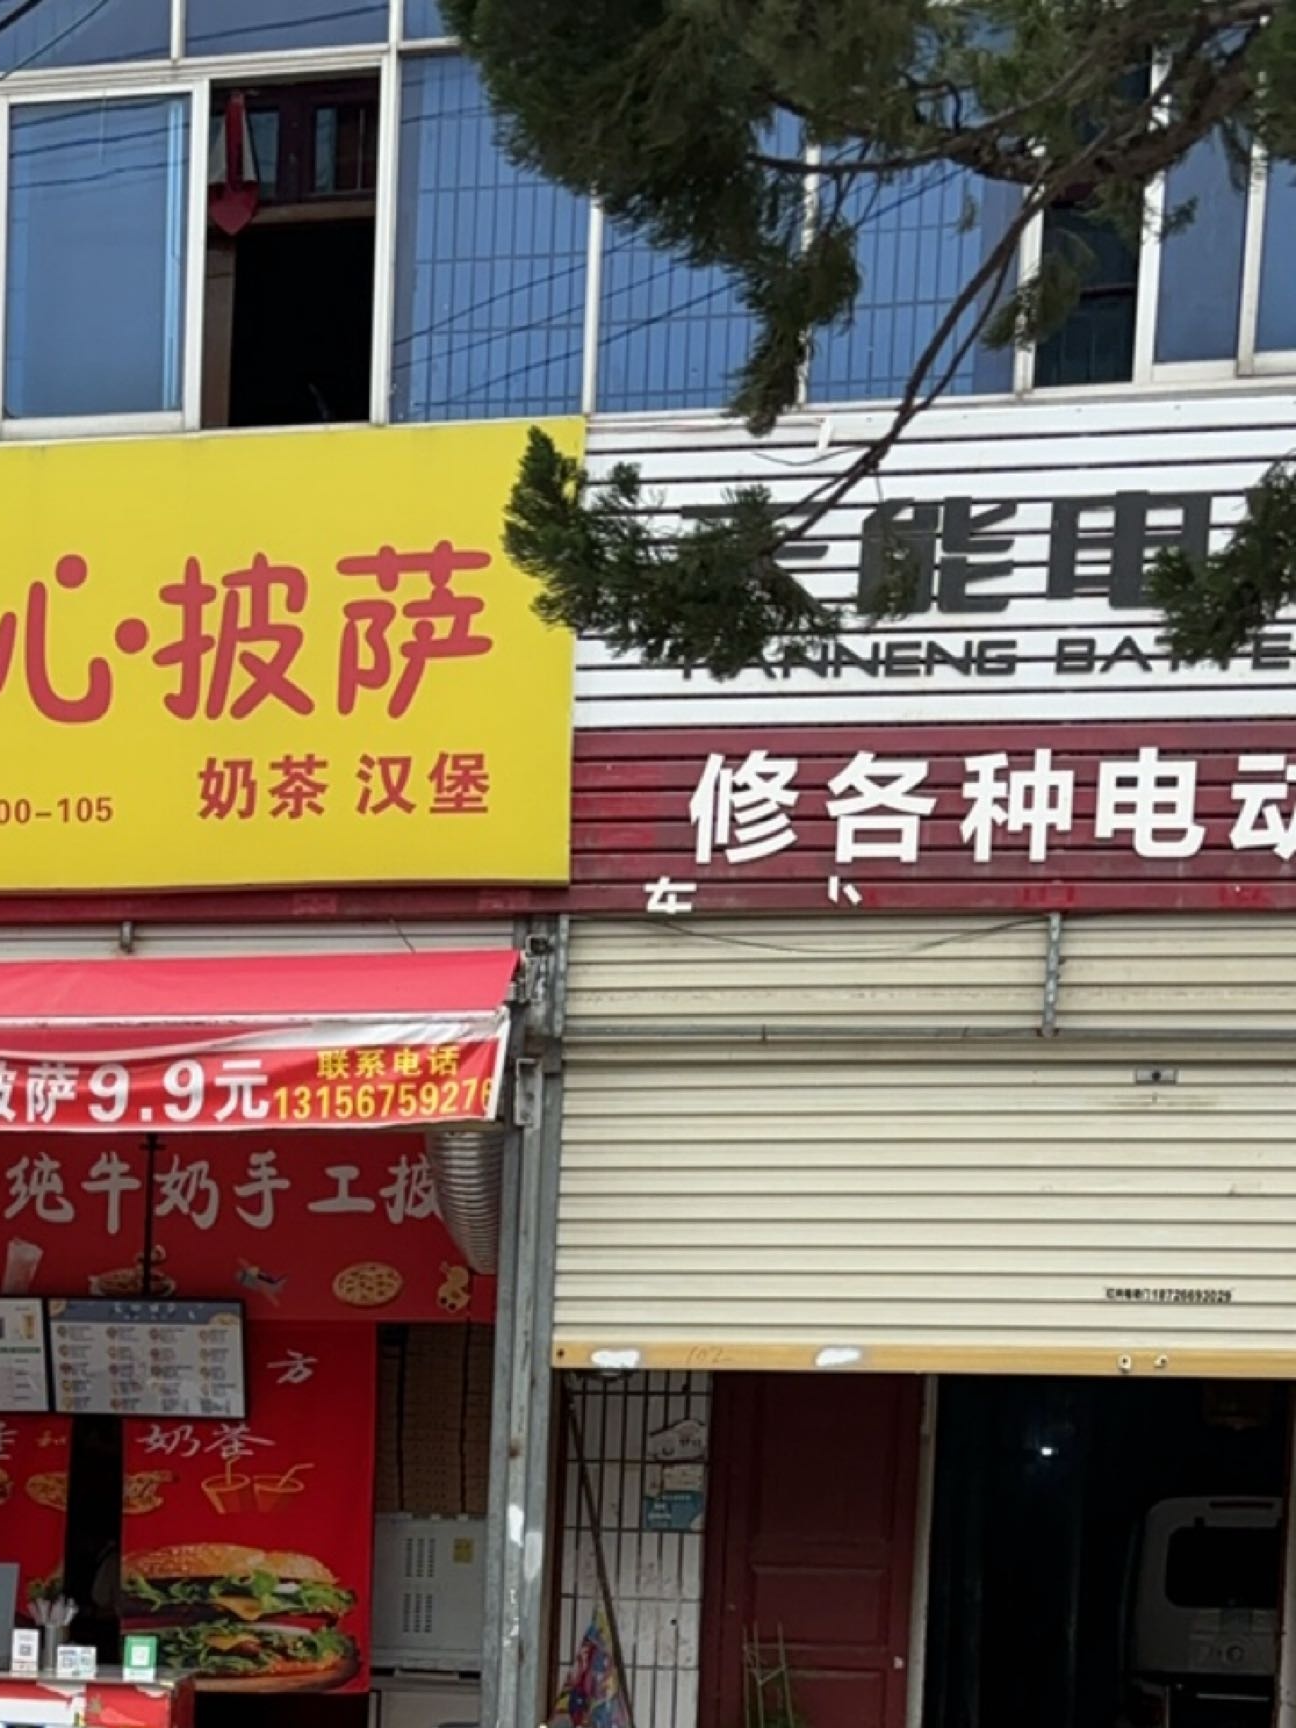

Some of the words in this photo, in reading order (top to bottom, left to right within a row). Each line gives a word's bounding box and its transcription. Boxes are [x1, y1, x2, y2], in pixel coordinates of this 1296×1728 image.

[197, 756, 328, 820] 奶茶
[355, 751, 491, 816] 汉堡
[316, 1045, 462, 1082] 联系电话
[136, 1423, 276, 1458] 奶茶
